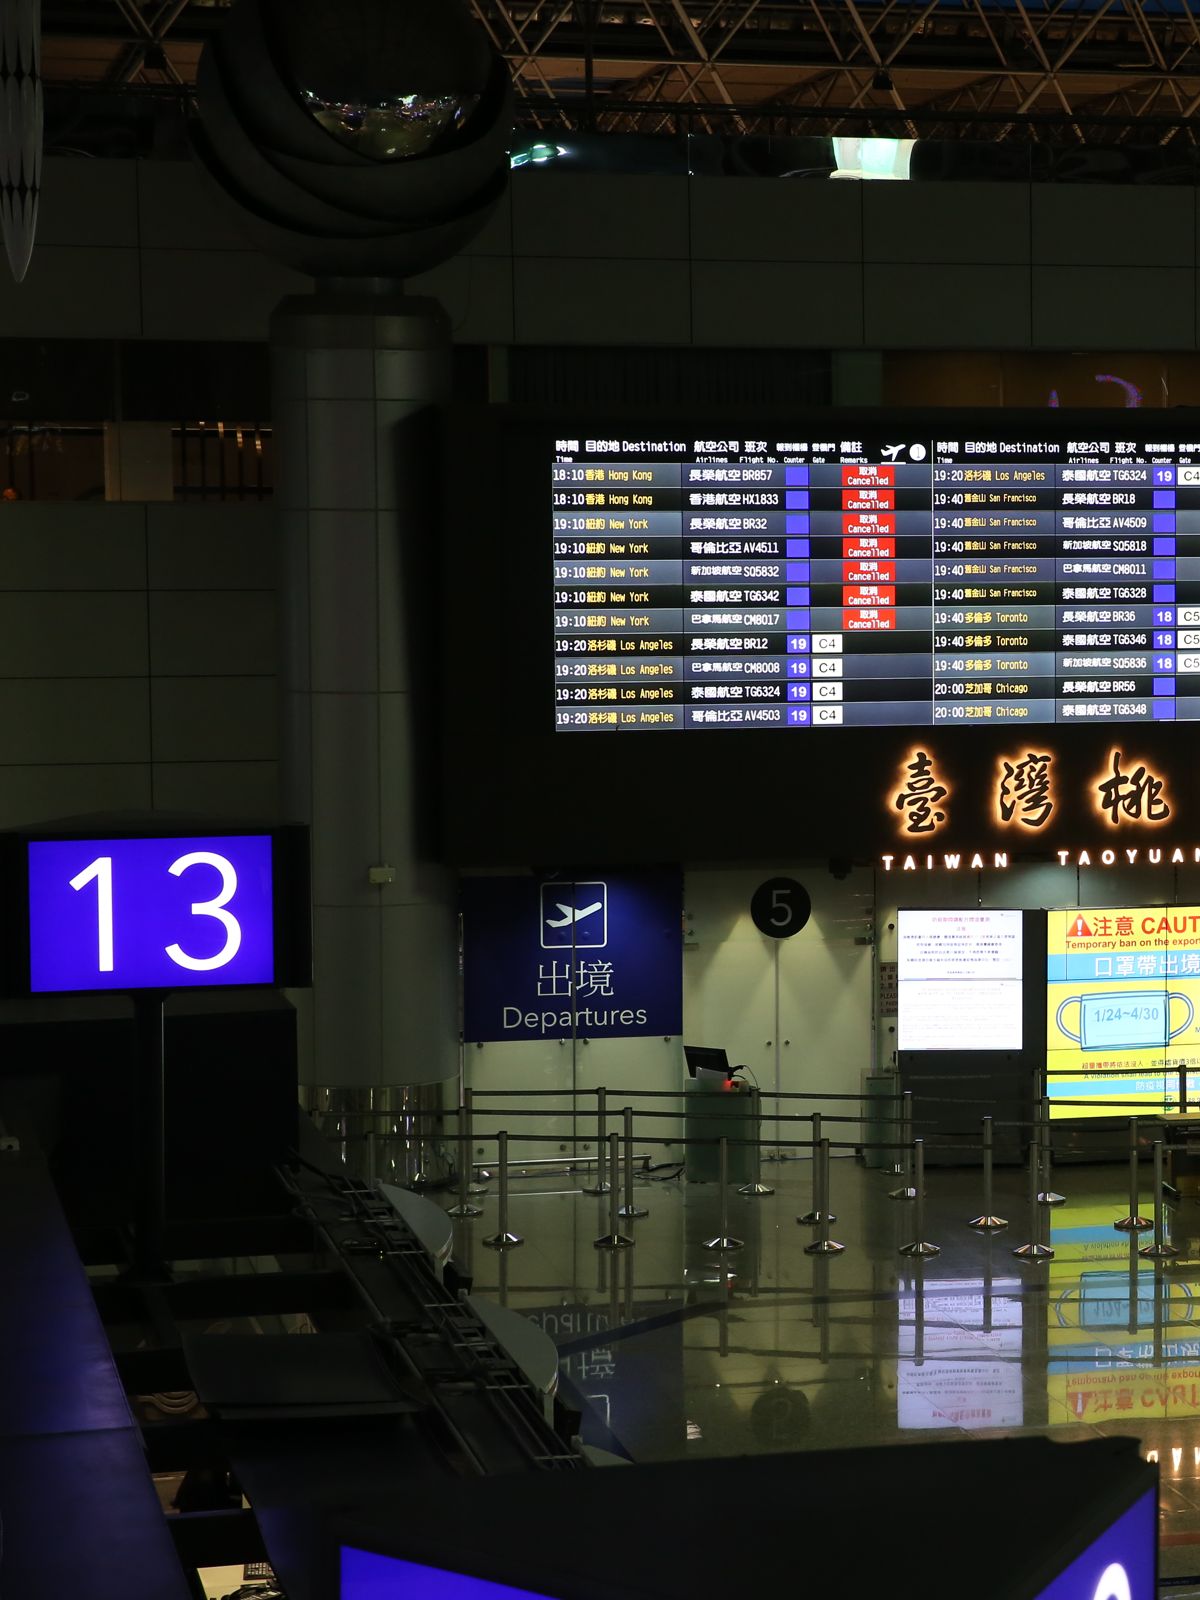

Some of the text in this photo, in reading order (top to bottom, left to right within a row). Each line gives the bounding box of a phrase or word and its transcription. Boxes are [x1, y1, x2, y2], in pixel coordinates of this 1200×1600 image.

[556, 440, 619, 452] 時間 目的地
[623, 441, 686, 451] Destination
[694, 441, 862, 452] 航空公司 班次 備註
[1000, 442, 1059, 452] Destination
[553, 469, 772, 481] 18:10 香港 Hong Kong 長榮航空 BR857
[859, 467, 877, 475] 取消
[848, 477, 888, 485] Cancelled
[935, 494, 963, 504] 19:40
[990, 494, 1000, 502] San
[1004, 494, 1036, 502] Francisco
[1062, 493, 1111, 504] 長榮航空
[1113, 494, 1135, 504] BR18
[554, 518, 767, 529] 19:10 紐約 New York 長榮航空 BR32
[860, 515, 877, 523] 取消
[848, 525, 889, 533] Cancelled
[935, 611, 1135, 623] 19:40 多倫多 Toronto 長榮航空 BR36
[1157, 612, 1172, 622] 18
[556, 638, 768, 651] 19:20 洛杉磯 Los Angeles 長榮航空 BR12
[791, 639, 806, 649] 19
[817, 639, 837, 648] C4
[935, 681, 1135, 694] 20:00 芝加哥 Chicago 長榮航空 BR56
[883, 853, 1009, 871] TAIWAN
[68, 850, 242, 973] 13
[771, 889, 792, 926] 5
[1093, 916, 1135, 936] 注意
[1066, 940, 1117, 950] Temporary
[1120, 938, 1137, 947] ban
[1154, 937, 1169, 946] the
[1095, 954, 1200, 976] 口罩帶出境
[537, 959, 615, 998] 出境
[502, 1003, 647, 1032] Departures
[1094, 1008, 1159, 1022] 1/24~4/30
